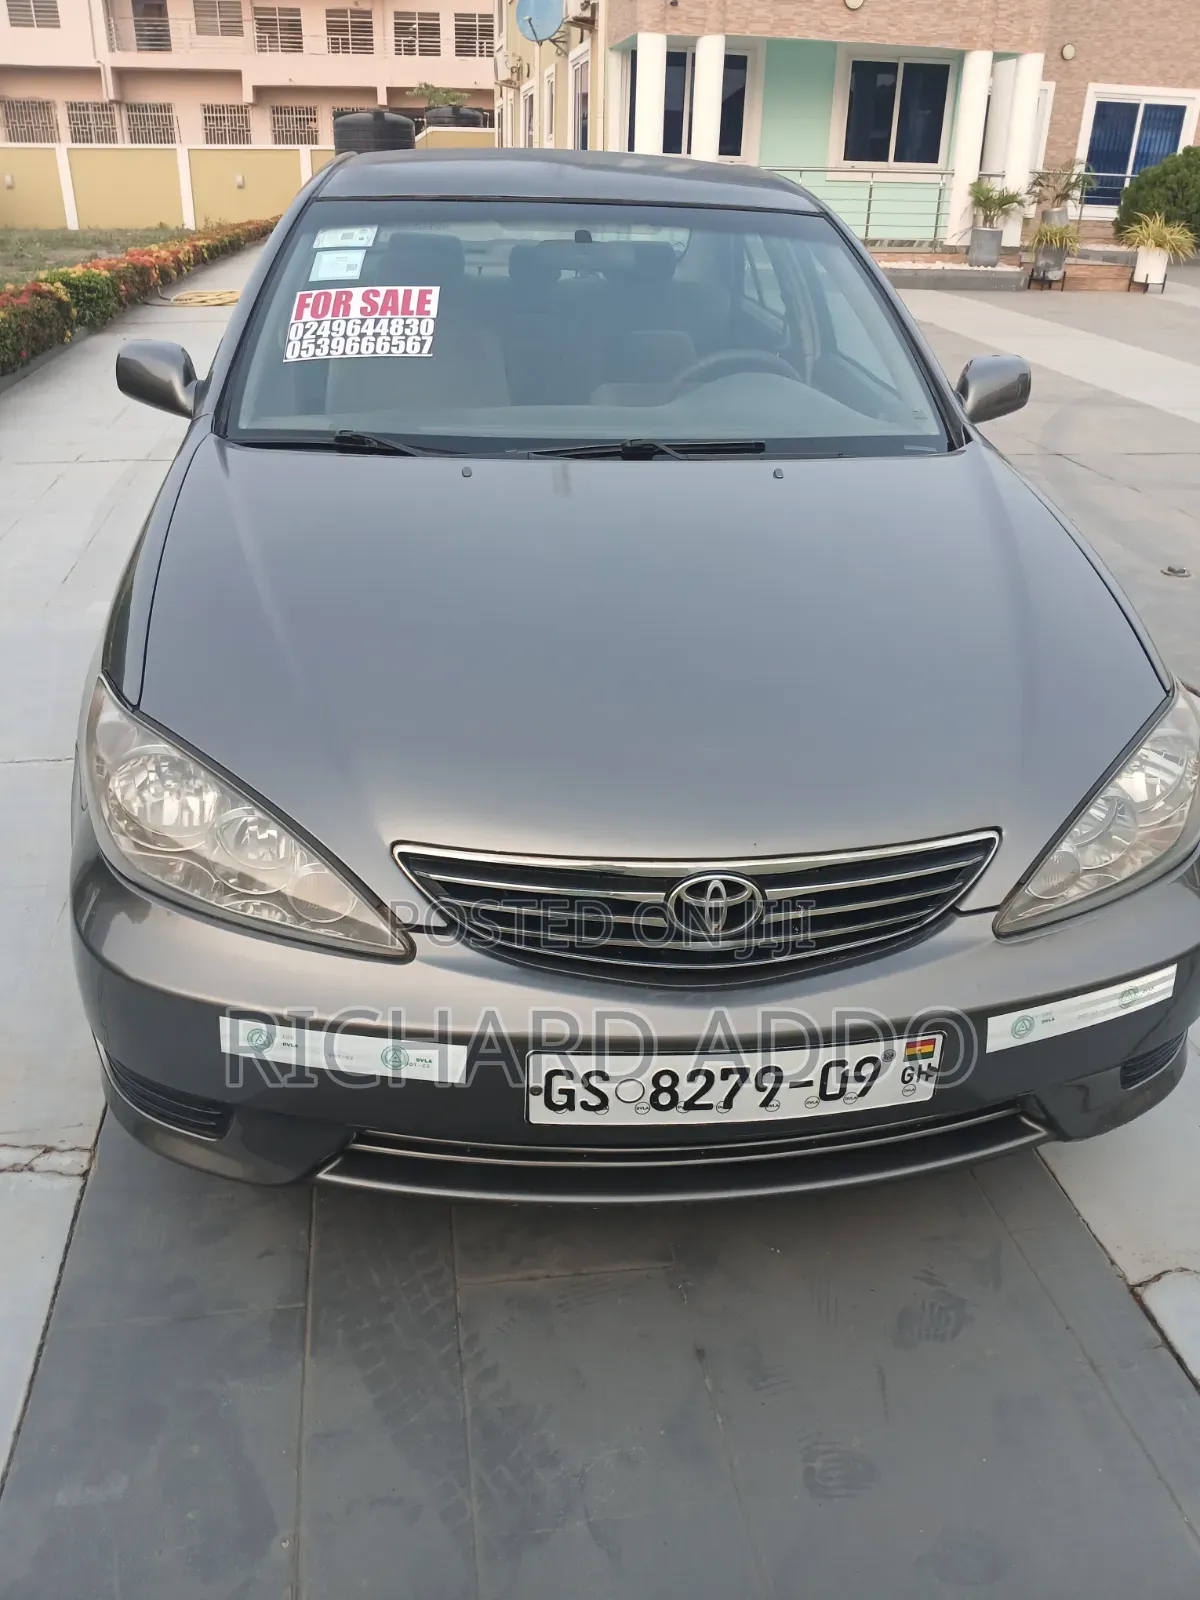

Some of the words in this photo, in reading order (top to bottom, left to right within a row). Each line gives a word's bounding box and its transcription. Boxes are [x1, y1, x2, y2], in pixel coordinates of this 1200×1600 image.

[294, 290, 353, 321] FOR
[359, 288, 433, 317] SALE
[289, 318, 435, 341] 0249644830
[286, 336, 433, 359] 0539666567
[543, 1069, 610, 1112] GS
[649, 1055, 882, 1112] 8279-09
[900, 1062, 937, 1085] GH
